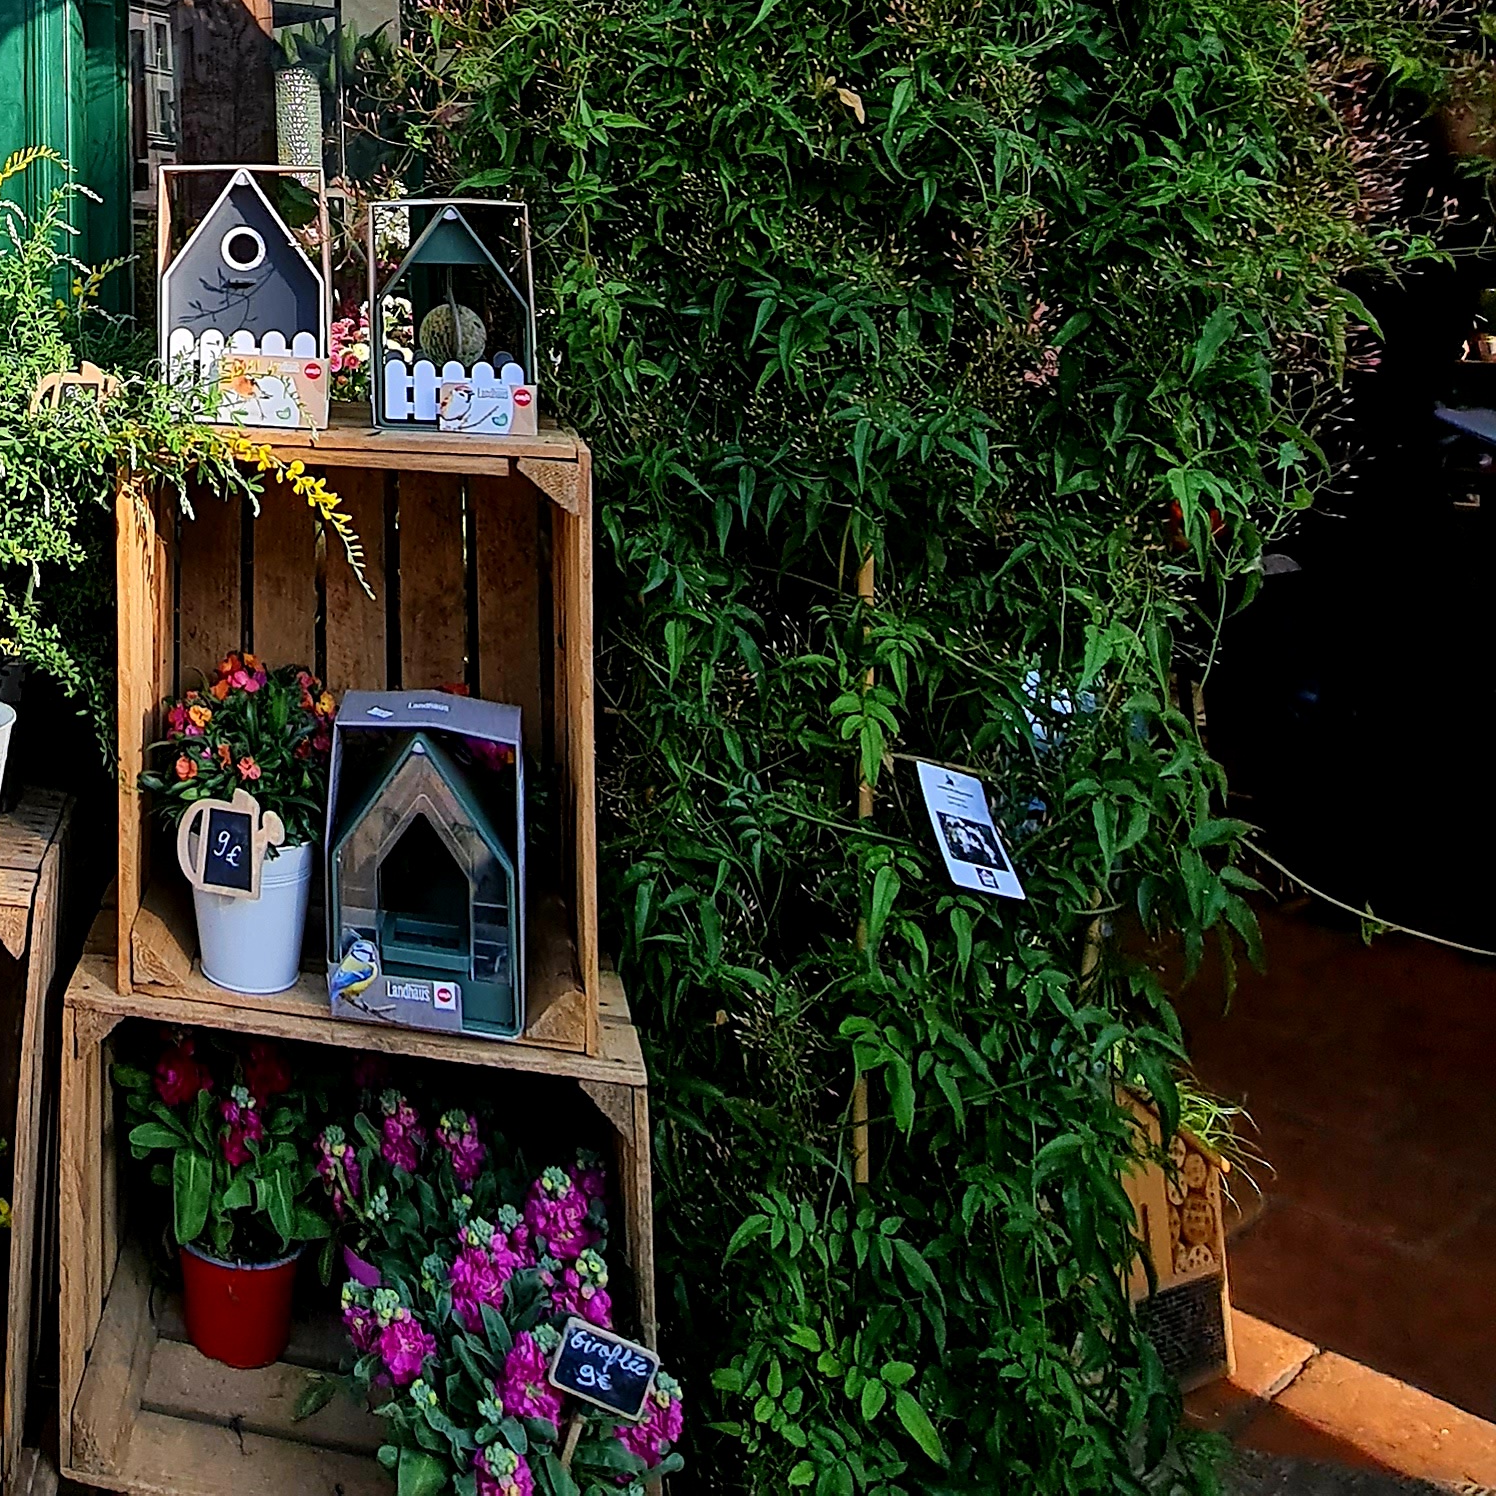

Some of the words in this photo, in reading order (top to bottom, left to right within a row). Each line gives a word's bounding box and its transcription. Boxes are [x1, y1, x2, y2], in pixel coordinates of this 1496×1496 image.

[407, 701, 450, 713] Landhaus
[386, 980, 431, 1002] Landhaus
[576, 1364, 613, 1391] 9€
